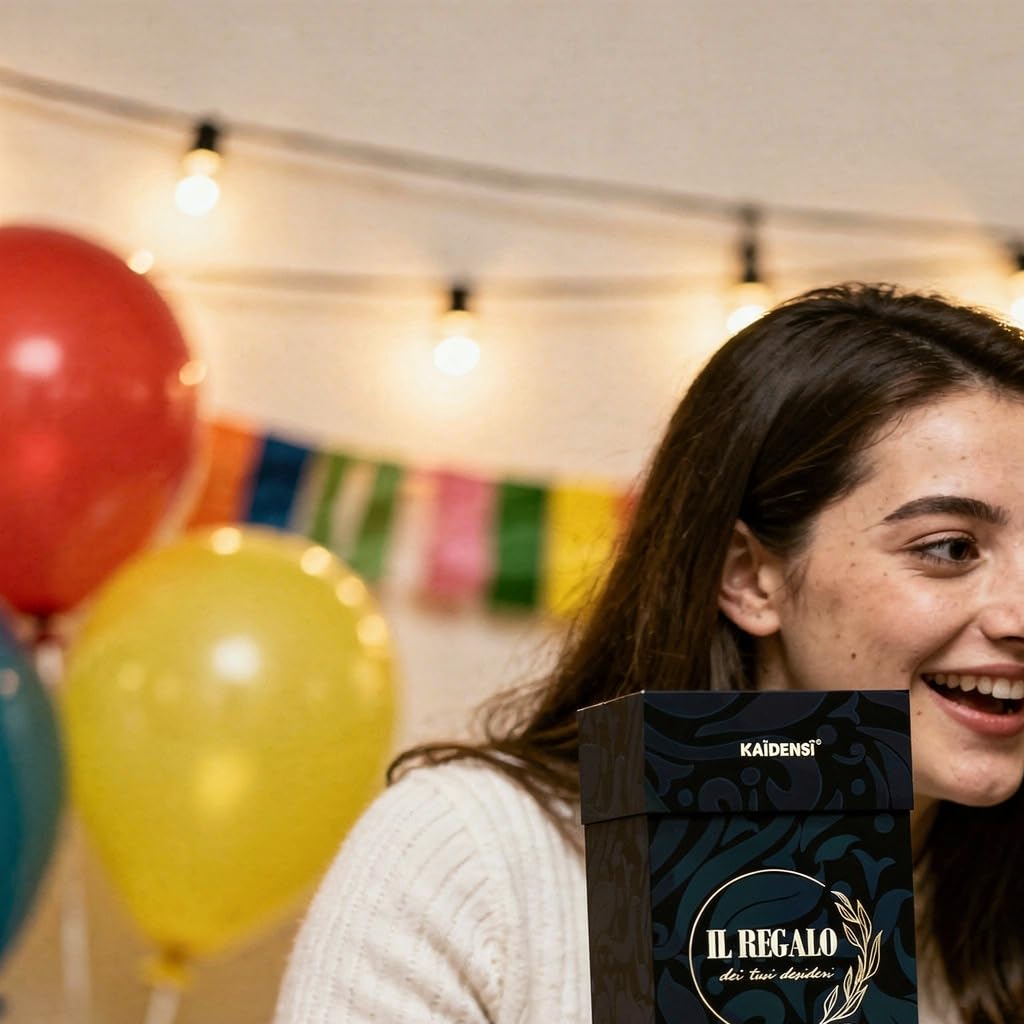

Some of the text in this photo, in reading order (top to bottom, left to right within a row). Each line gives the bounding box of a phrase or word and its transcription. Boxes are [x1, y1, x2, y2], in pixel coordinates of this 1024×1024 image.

[706, 928, 838, 960] IL REGALO
[719, 967, 745, 982] dei
